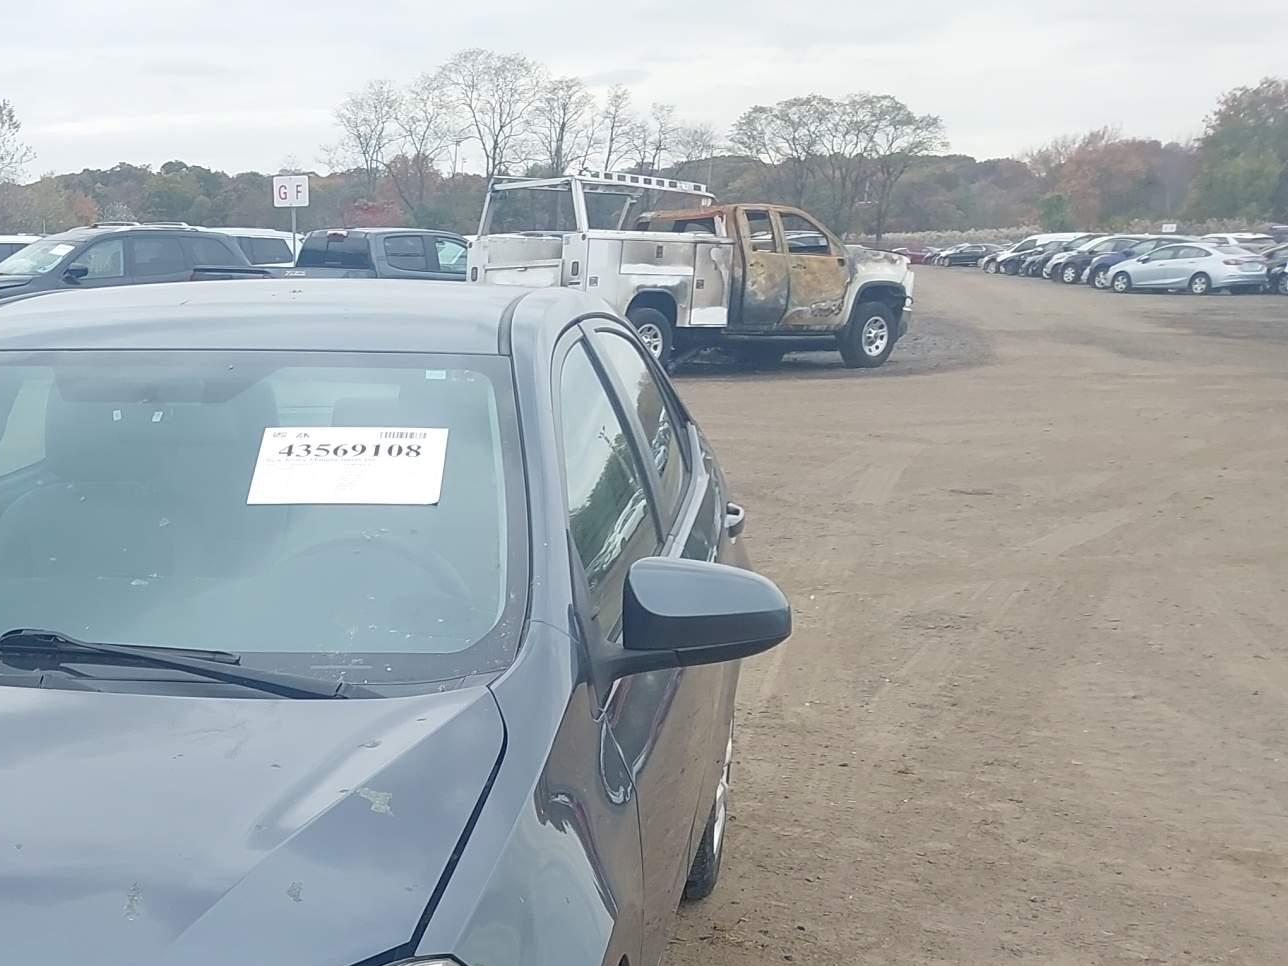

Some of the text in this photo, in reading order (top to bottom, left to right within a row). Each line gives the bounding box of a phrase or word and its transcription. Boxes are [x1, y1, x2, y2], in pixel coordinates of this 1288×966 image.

[278, 184, 303, 201] G F
[278, 443, 423, 458] 43569108
